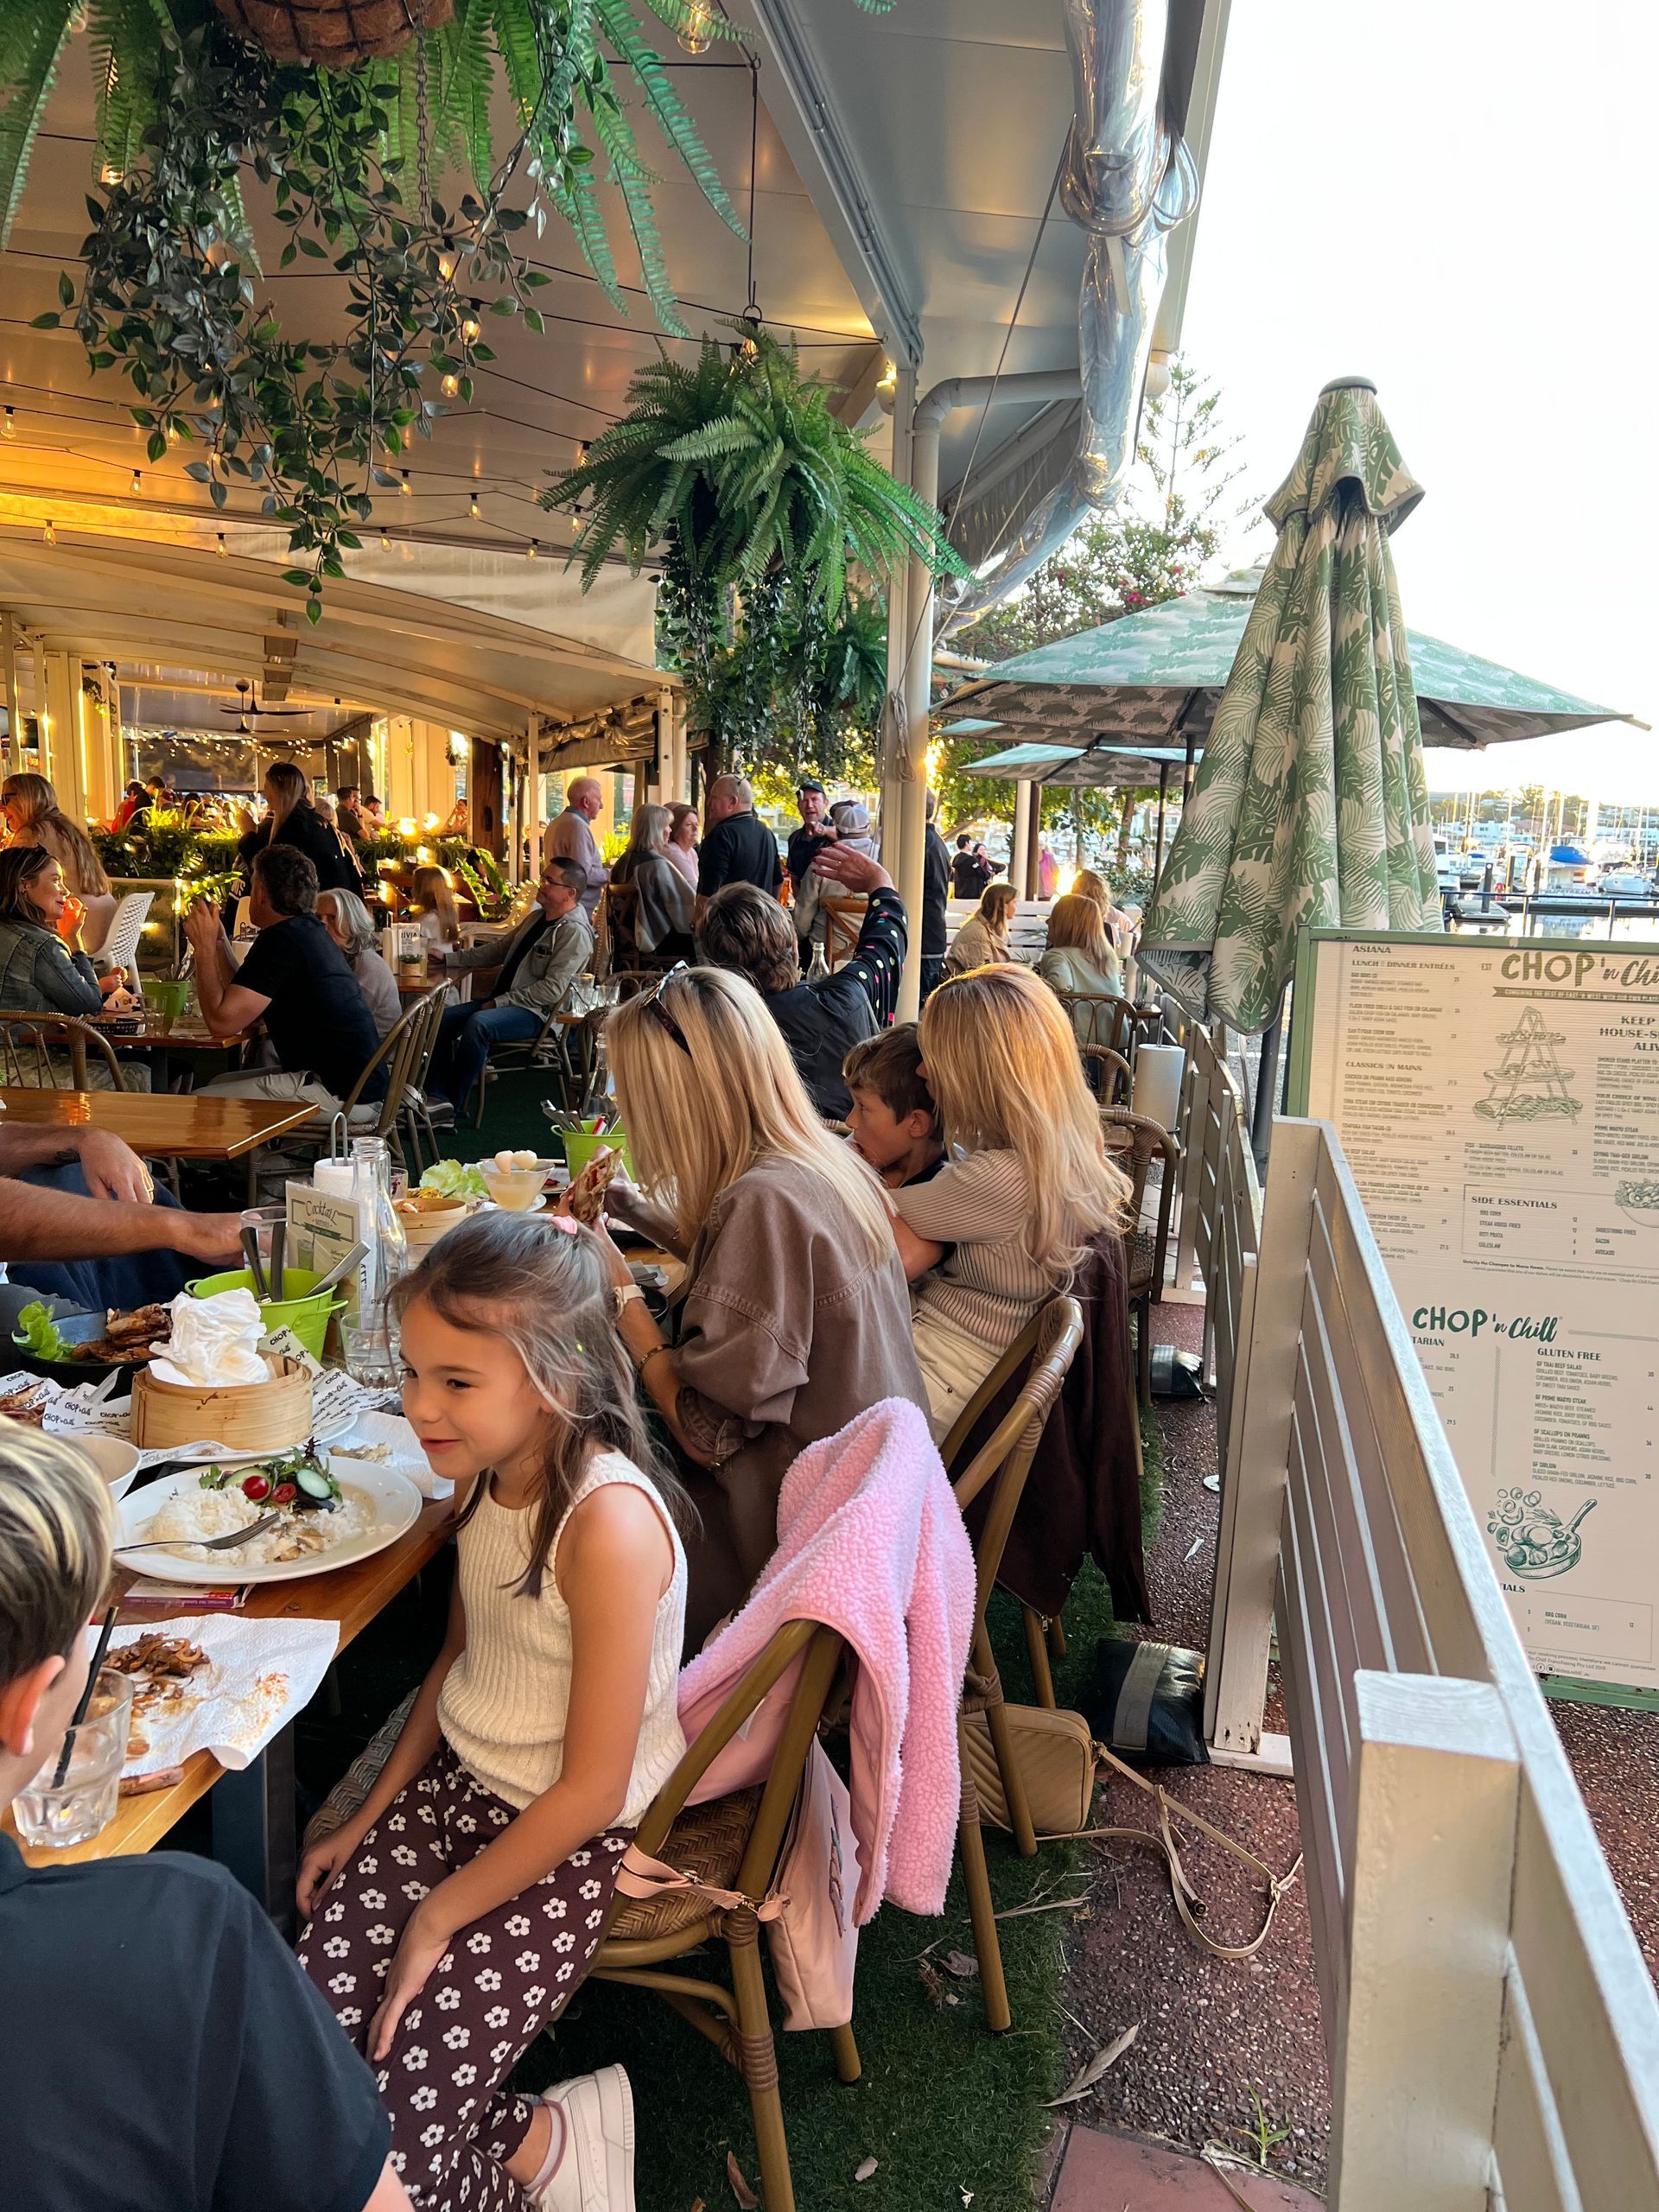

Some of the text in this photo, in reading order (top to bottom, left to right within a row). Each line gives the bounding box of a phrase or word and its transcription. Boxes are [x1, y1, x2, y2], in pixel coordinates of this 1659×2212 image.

[1501, 950, 1595, 988] CHOP
[1621, 1015, 1656, 1026] KEEP
[1471, 1196, 1557, 1209] SIDE ESSENTIALS
[305, 1200, 340, 1226] Cocktail
[1412, 1306, 1558, 1343] CHOP 'n Chill
[270, 1330, 287, 1345] CHOP
[1537, 1348, 1601, 1361] GLUTEN FREE
